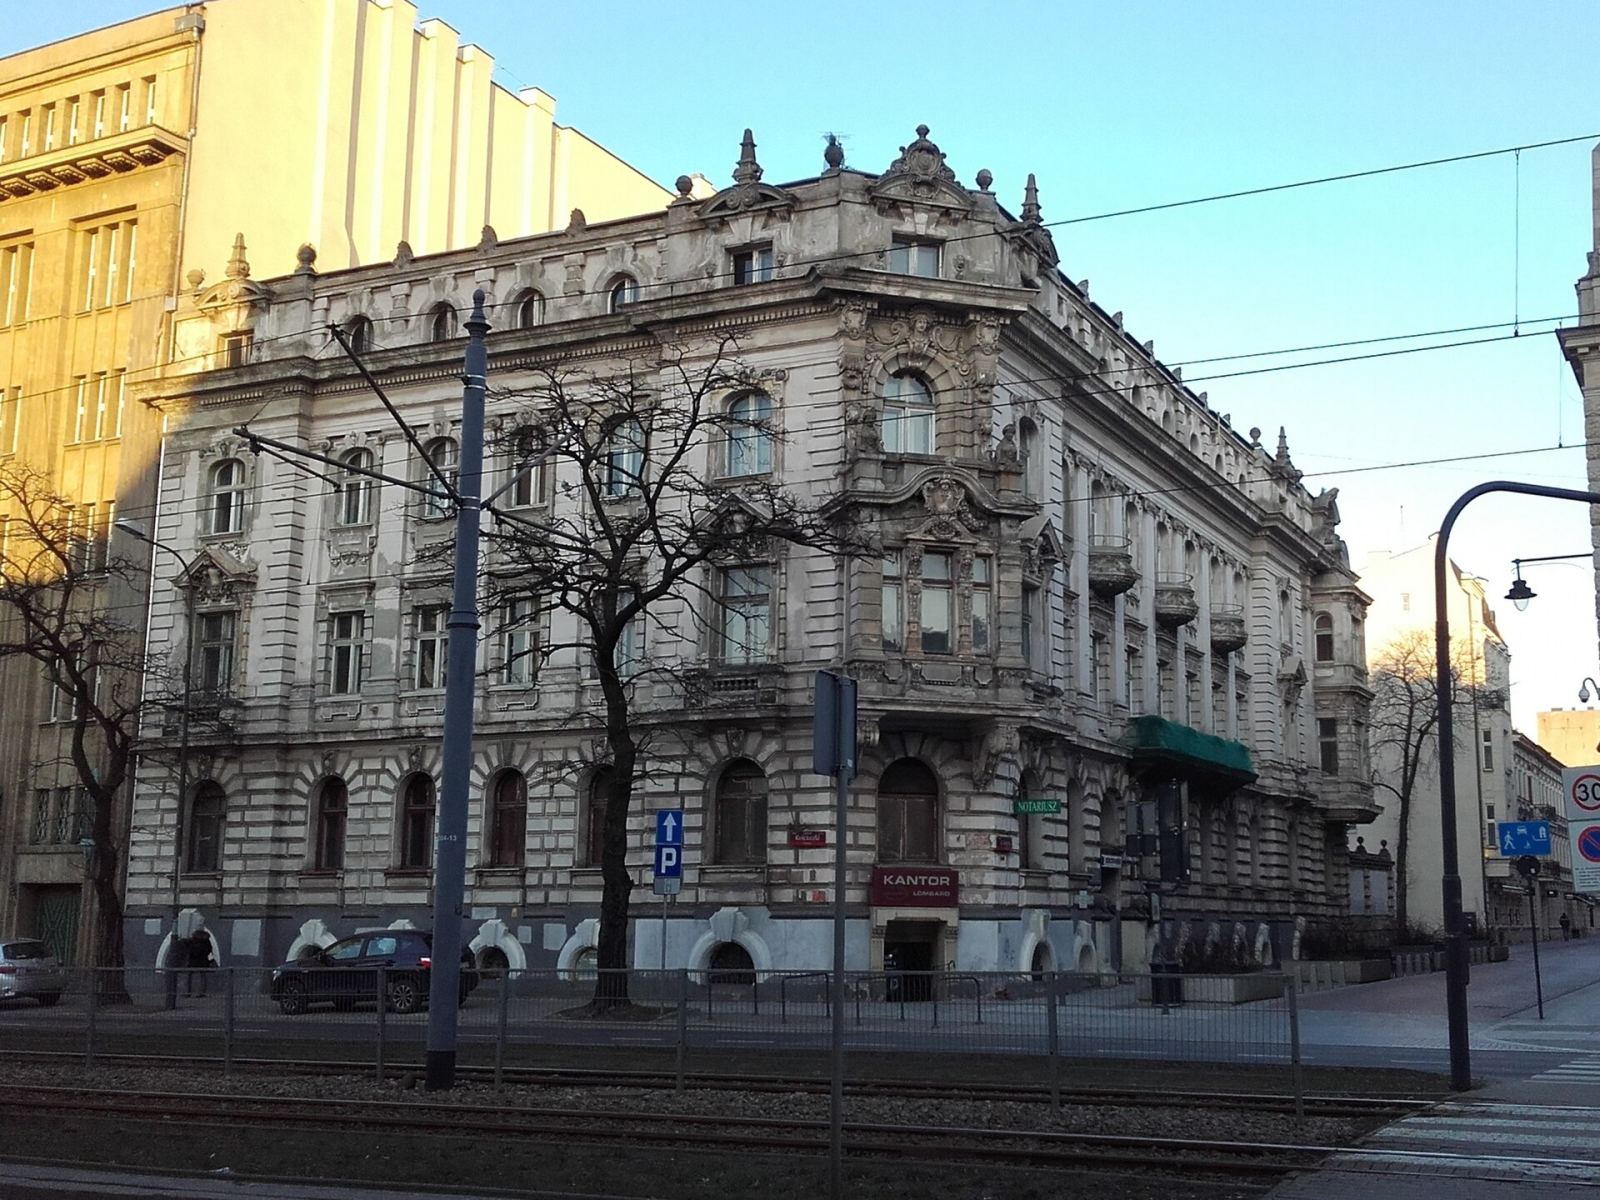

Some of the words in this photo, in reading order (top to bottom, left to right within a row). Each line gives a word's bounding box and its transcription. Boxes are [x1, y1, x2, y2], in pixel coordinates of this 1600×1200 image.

[1577, 782, 1600, 802] 30
[1018, 801, 1057, 812] NOTARIUSZ
[661, 847, 677, 874] P
[883, 875, 950, 886] KANTOR
